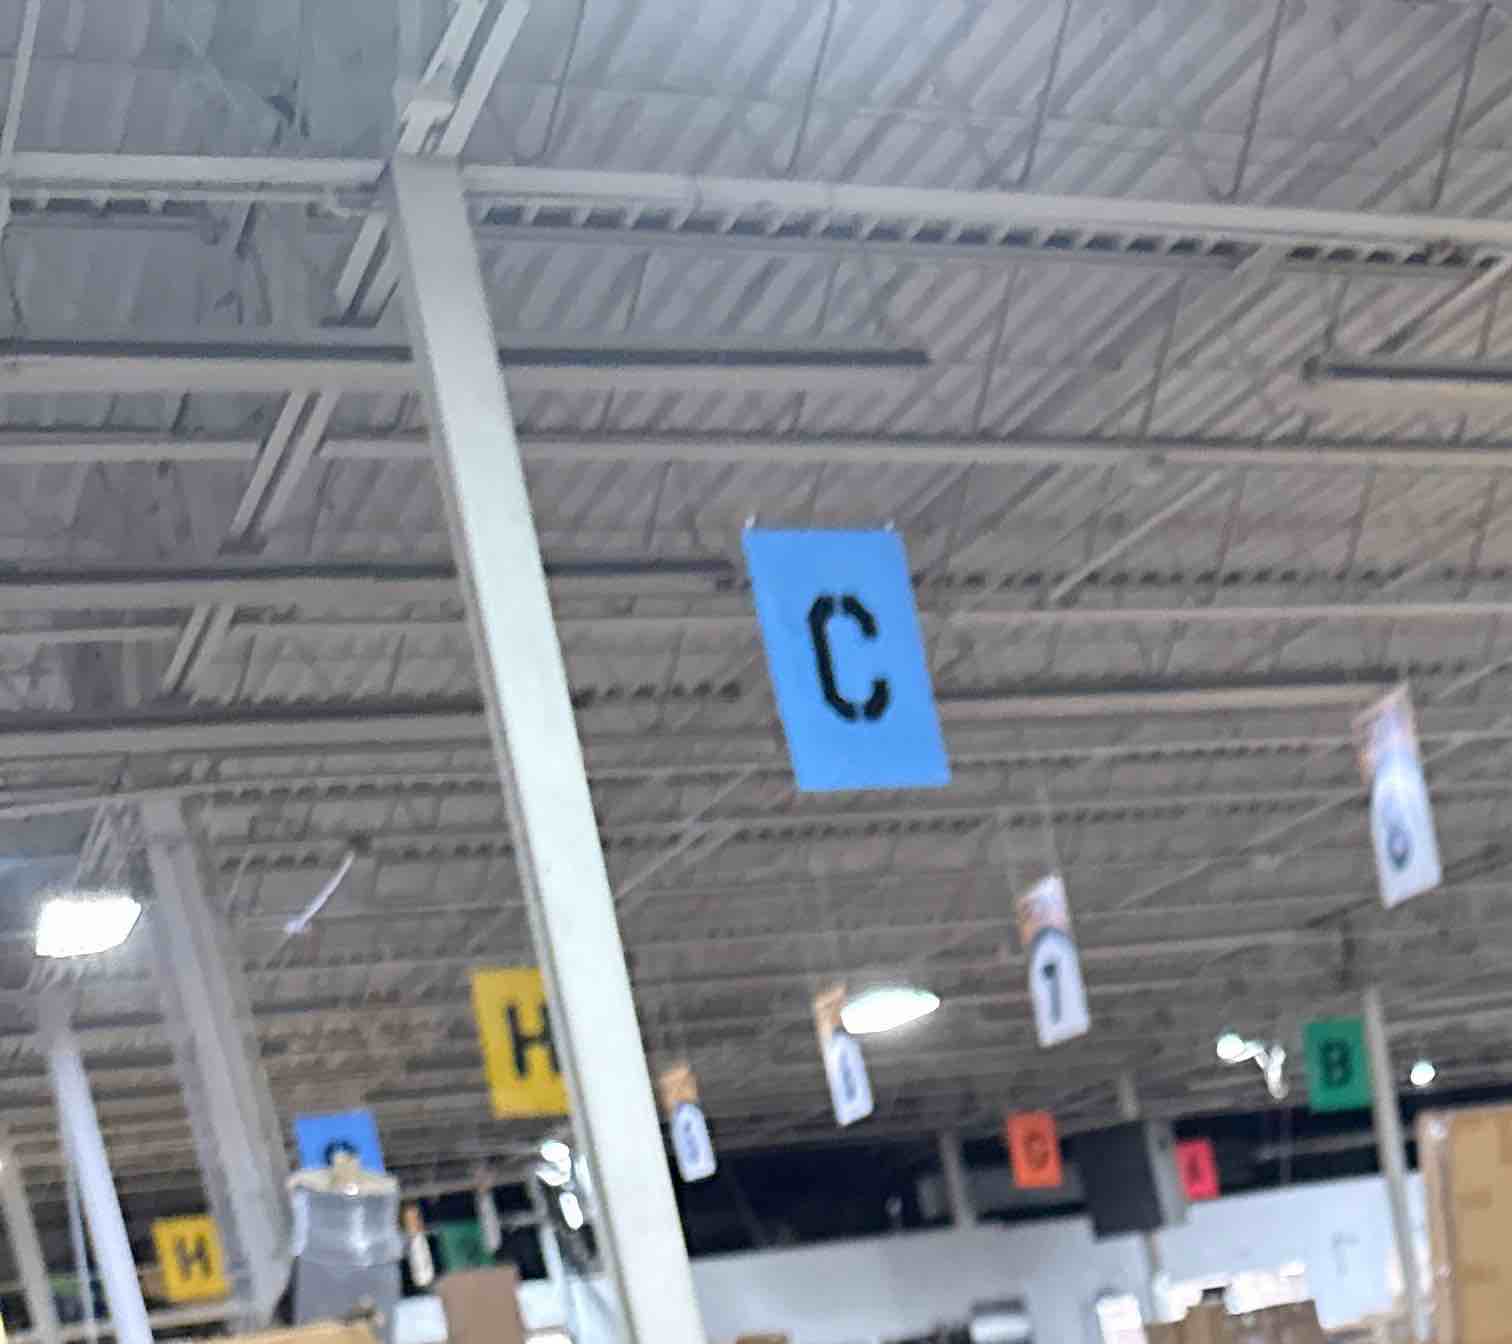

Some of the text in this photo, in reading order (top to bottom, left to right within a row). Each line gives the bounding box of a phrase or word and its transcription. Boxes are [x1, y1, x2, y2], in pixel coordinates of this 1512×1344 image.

[807, 595, 890, 721] C
[506, 1003, 561, 1077] H
[1319, 1039, 1353, 1089] B
[174, 1231, 213, 1283] H
